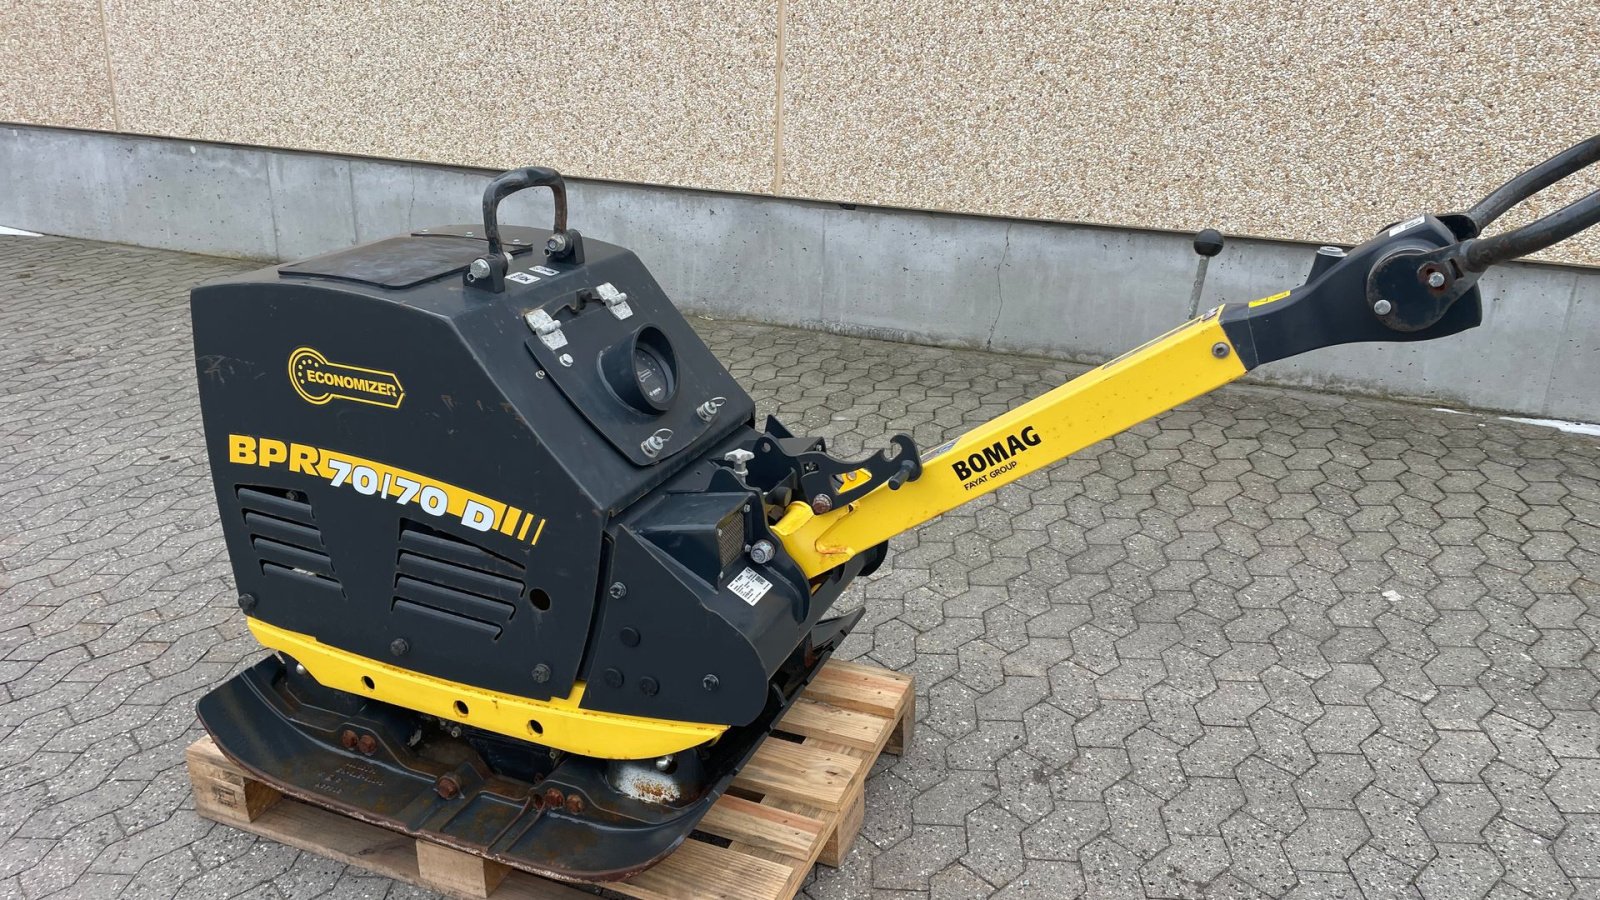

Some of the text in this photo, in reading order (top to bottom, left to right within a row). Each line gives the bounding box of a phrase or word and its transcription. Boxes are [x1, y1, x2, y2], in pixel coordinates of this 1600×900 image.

[306, 369, 398, 397] ECONOMIZER
[951, 426, 1042, 482] BOMAG
[963, 460, 1018, 491] FAYAT GROUP
[229, 434, 322, 476] BPR
[461, 500, 496, 532] D
